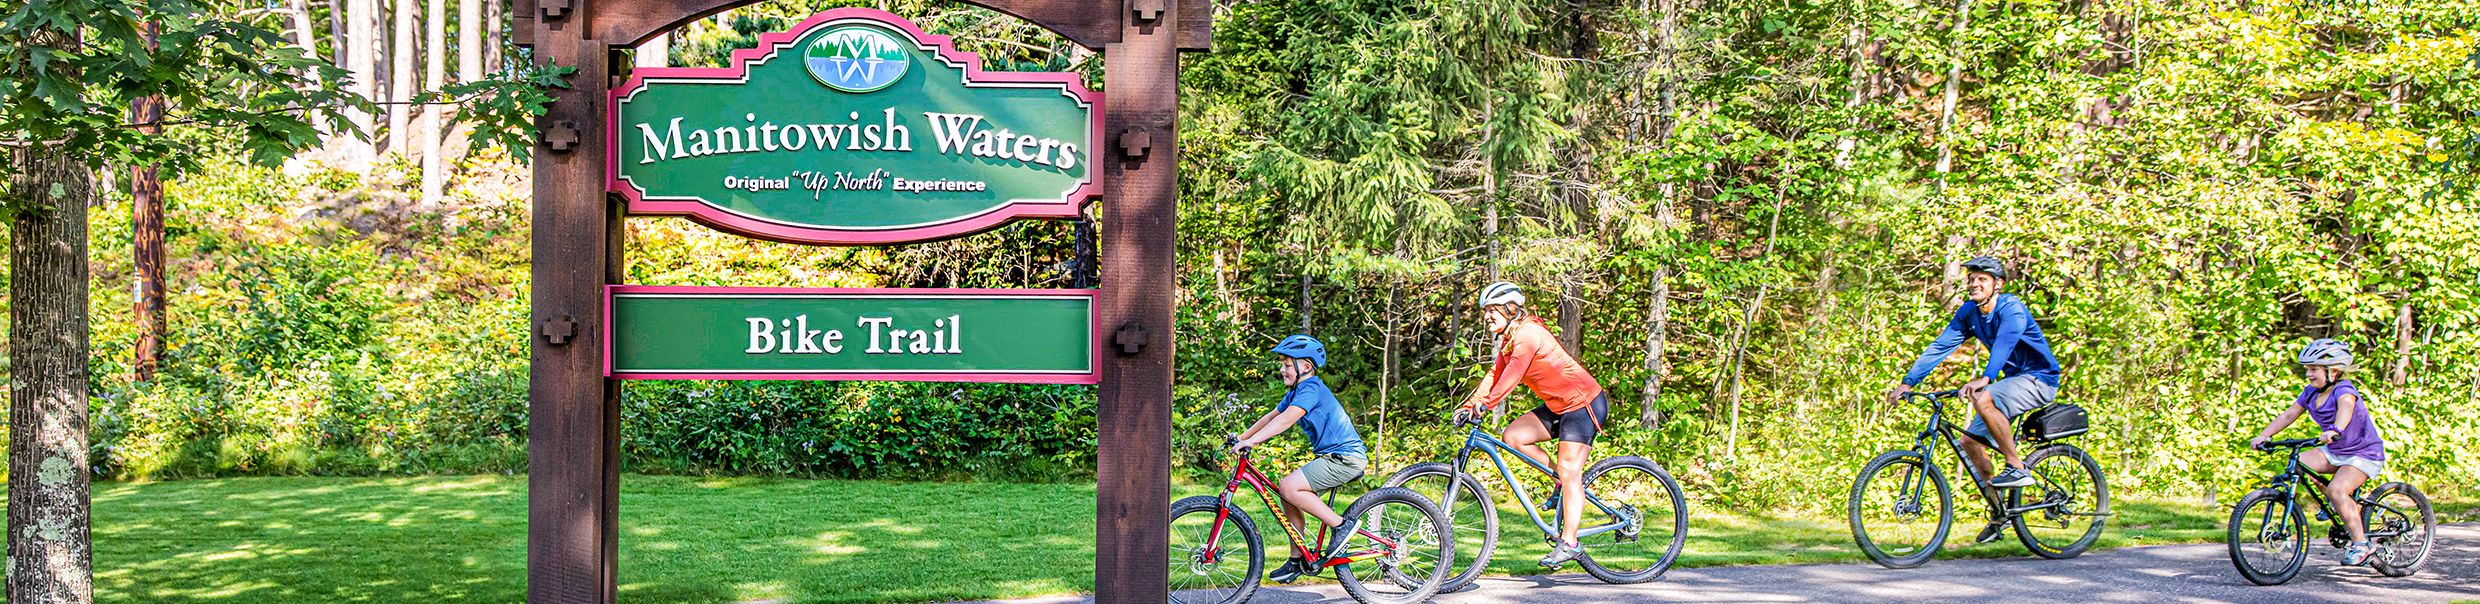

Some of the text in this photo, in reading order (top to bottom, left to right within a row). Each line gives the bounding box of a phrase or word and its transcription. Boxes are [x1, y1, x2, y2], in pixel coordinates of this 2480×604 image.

[636, 106, 1077, 169] Manitowish Waters
[724, 175, 790, 193] Original
[893, 177, 986, 194] Experience
[745, 314, 963, 355] Bike Trail
